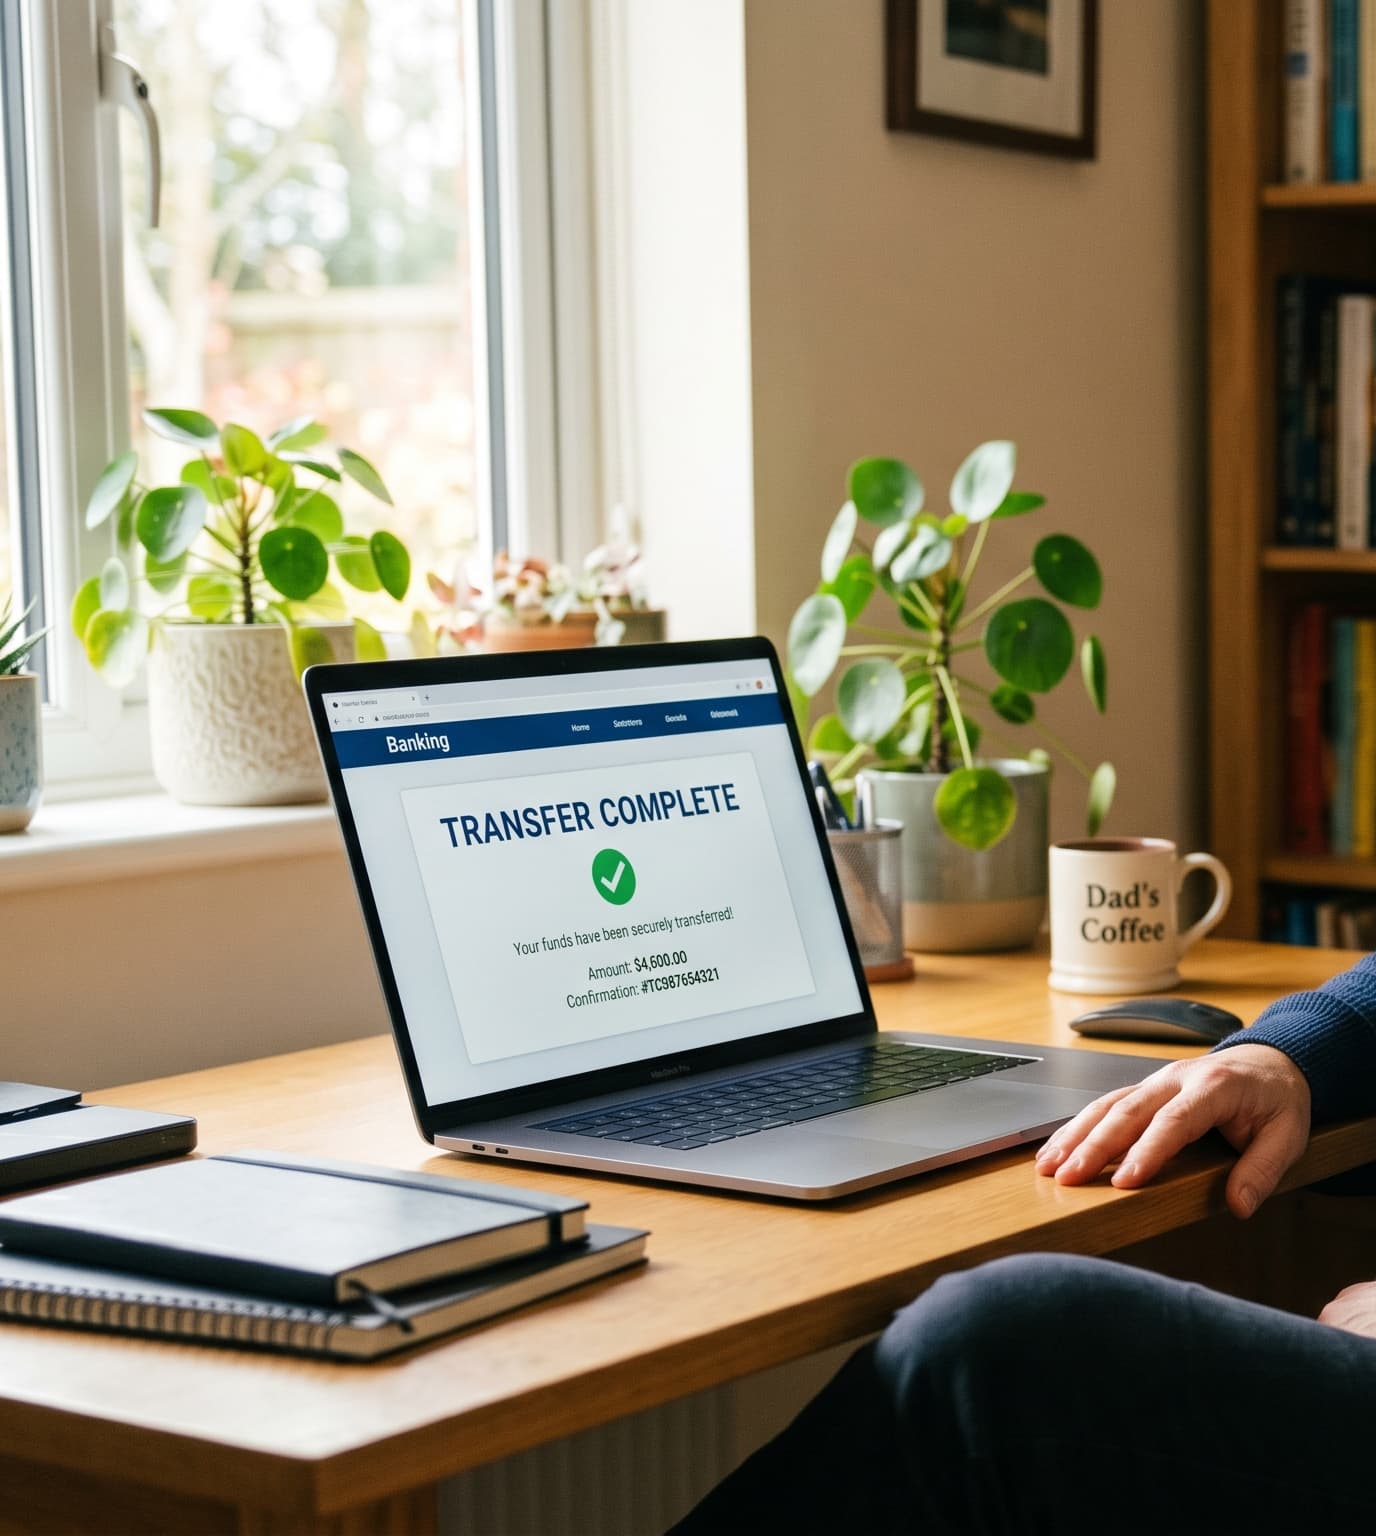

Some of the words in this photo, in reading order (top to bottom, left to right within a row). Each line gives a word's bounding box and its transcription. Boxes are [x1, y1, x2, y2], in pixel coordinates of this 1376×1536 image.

[386, 732, 450, 753] Banking
[440, 801, 594, 847] TRANSFER
[600, 783, 740, 827] COMPLETE
[1086, 882, 1160, 908] Dad's
[513, 942, 539, 956] Your
[542, 934, 573, 951] funds
[574, 931, 600, 945] have
[602, 927, 629, 941] been
[631, 917, 673, 936] securely
[675, 906, 734, 928] transferred!
[1081, 918, 1165, 943] Coffee
[588, 964, 632, 980] Amount:
[634, 950, 688, 972] $4,600.00
[566, 985, 639, 1008] Confirmation:
[641, 968, 720, 994] #TC987654321
